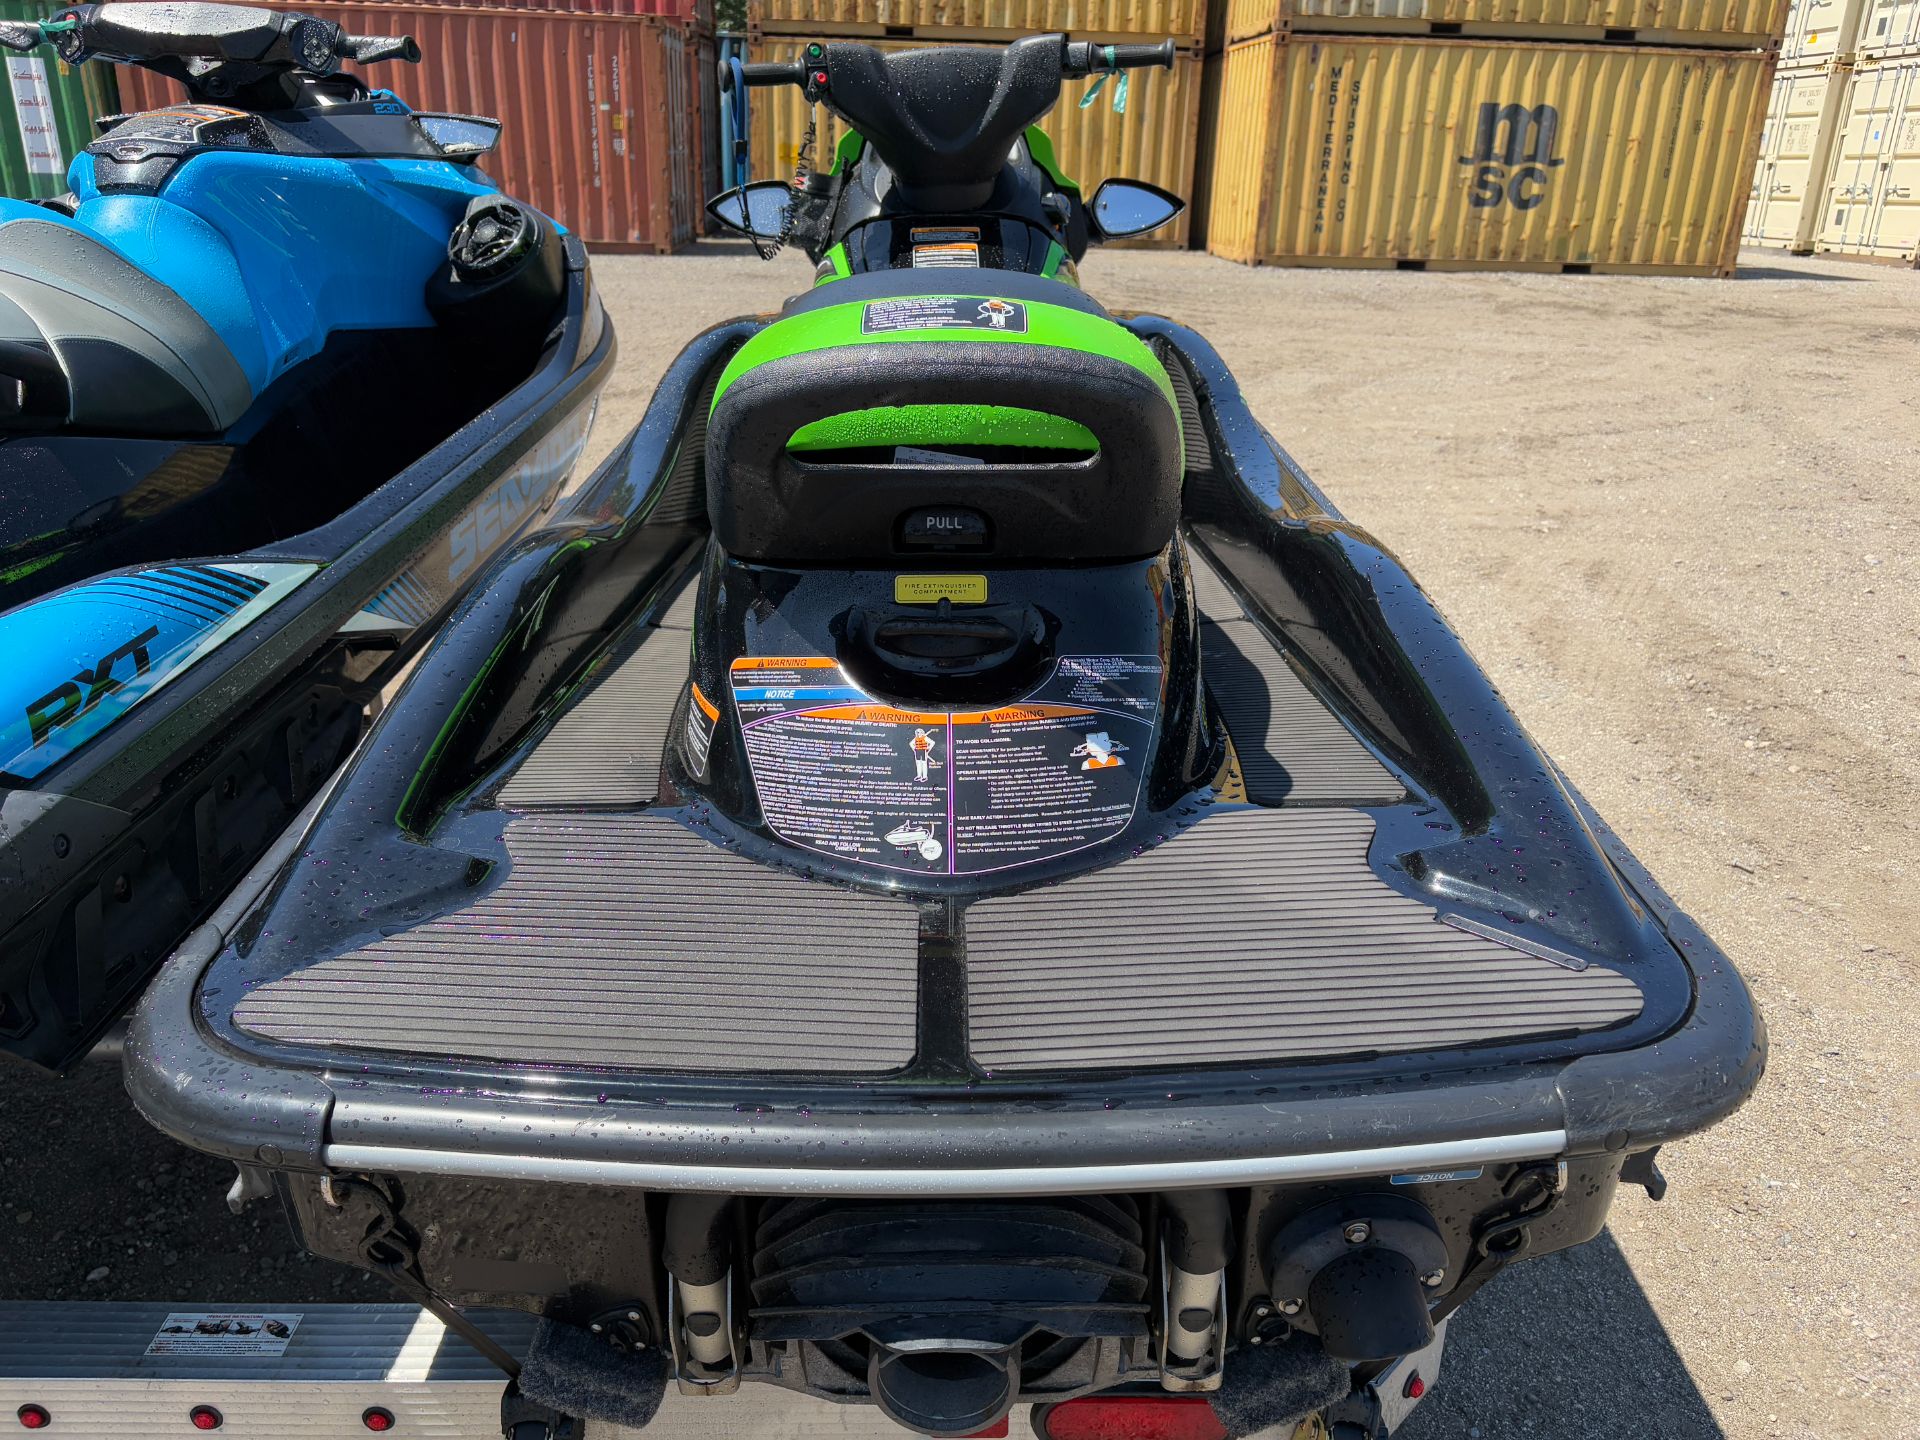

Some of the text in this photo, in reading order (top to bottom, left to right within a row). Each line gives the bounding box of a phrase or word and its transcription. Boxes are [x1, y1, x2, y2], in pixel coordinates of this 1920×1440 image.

[373, 102, 402, 114] 230
[1313, 66, 1343, 234] MEDITERRANEAN
[1336, 80, 1361, 222] SHIPPING CO
[926, 516, 963, 529] PULL
[767, 658, 807, 667] WARNING
[764, 690, 796, 699] NOTICE
[870, 713, 921, 722] WARNING
[994, 709, 1045, 720] WARNING
[1416, 1172, 1455, 1181] NOTICE
